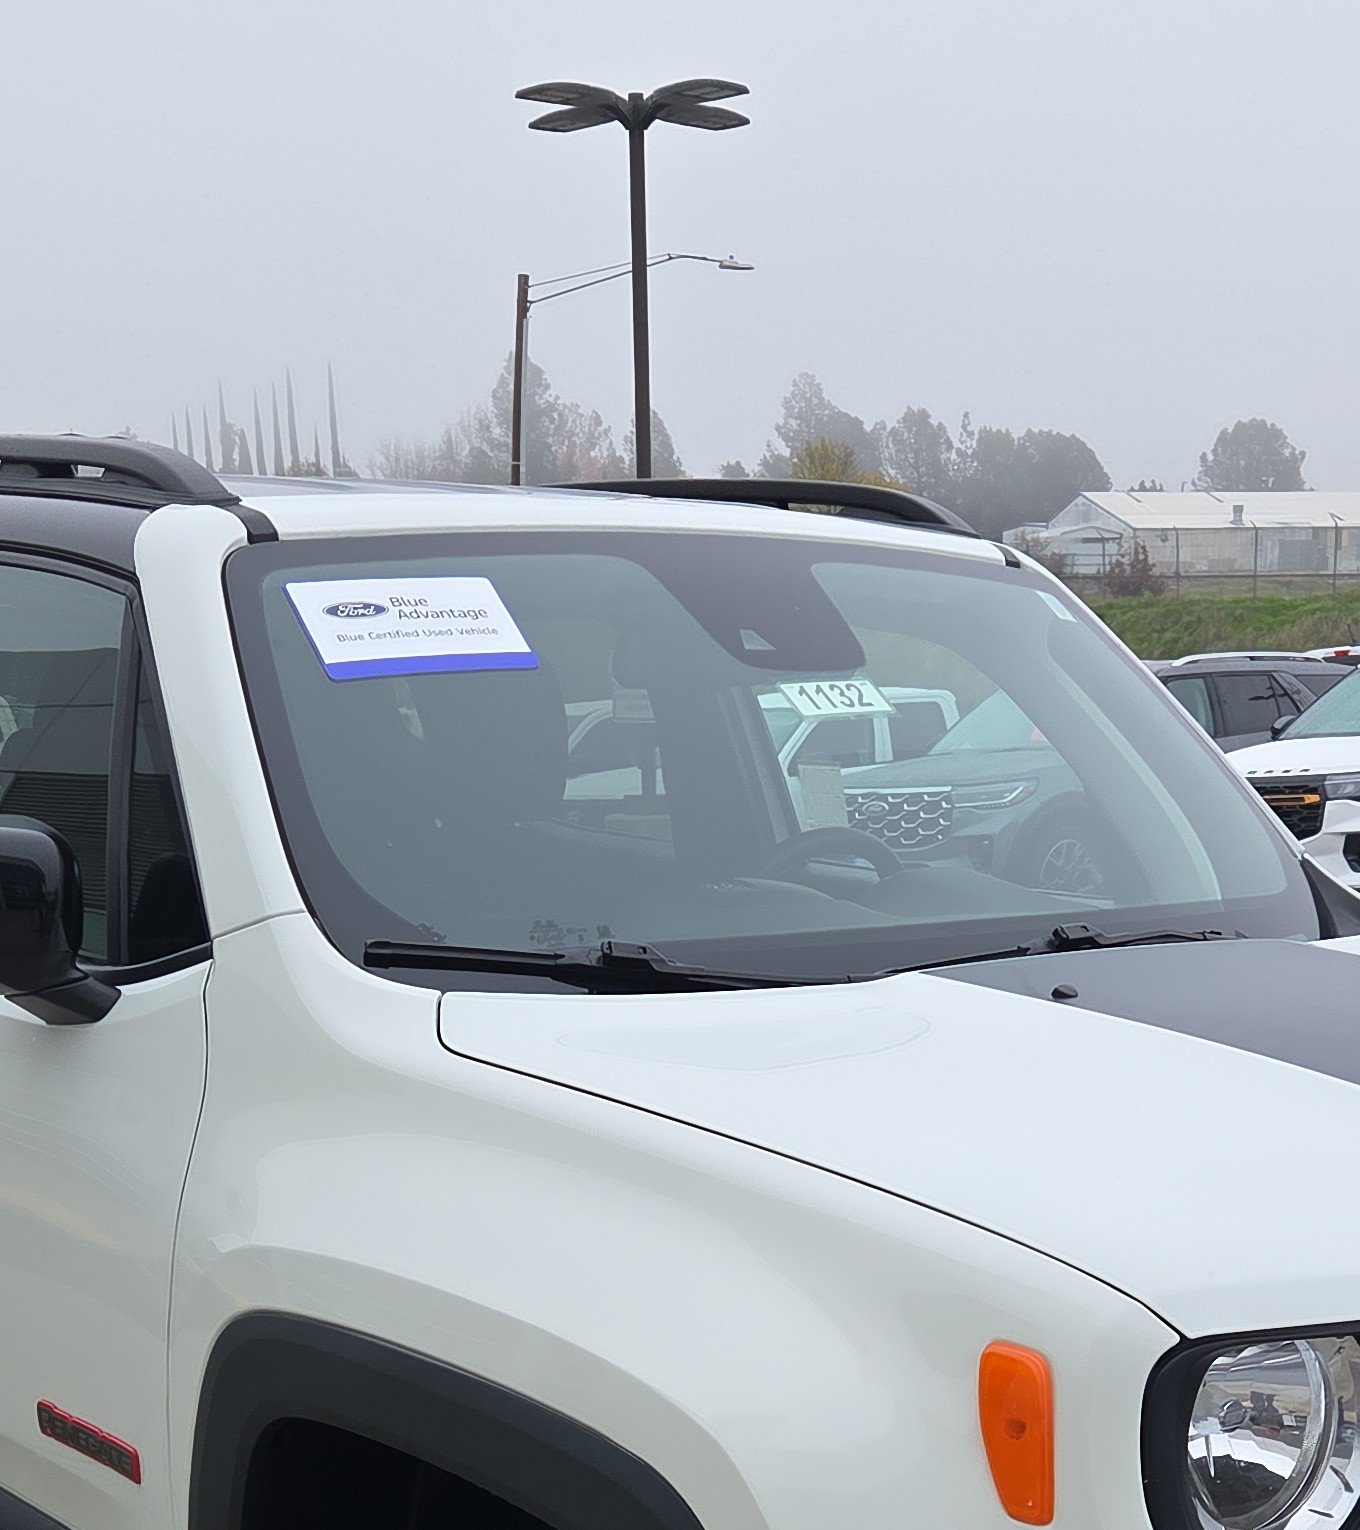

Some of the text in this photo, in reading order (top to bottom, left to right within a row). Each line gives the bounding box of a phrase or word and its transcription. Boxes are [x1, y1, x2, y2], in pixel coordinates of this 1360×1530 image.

[389, 596, 429, 608] Blue
[338, 604, 377, 616] Ford
[398, 608, 489, 622] Advantage
[337, 627, 499, 643] Blue Certified Used Vehicle
[798, 683, 874, 710] 1132
